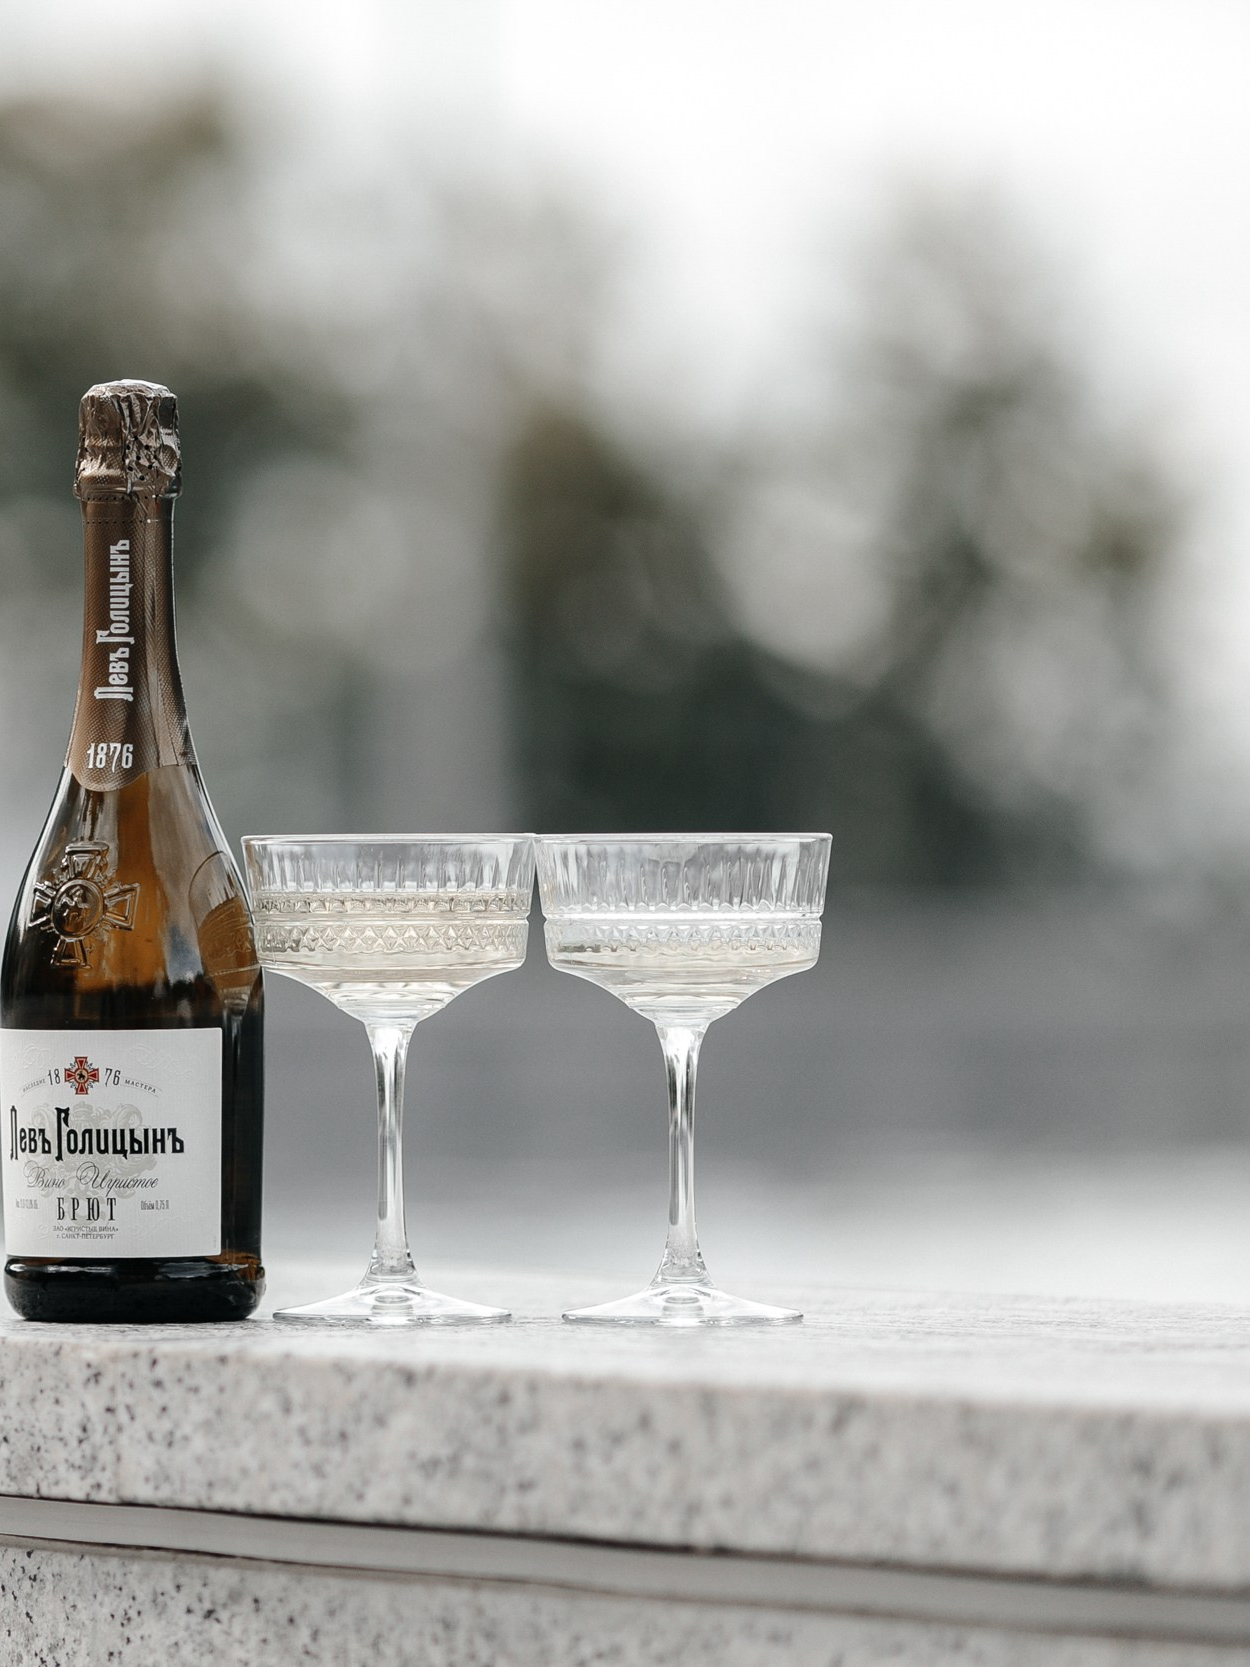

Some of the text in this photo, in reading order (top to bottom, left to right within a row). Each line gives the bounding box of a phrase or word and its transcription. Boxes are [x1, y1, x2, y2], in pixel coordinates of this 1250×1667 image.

[93, 539, 135, 702] Левъ Голицынъ
[87, 742, 134, 773] 1876
[47, 1068, 61, 1086] 18
[104, 1067, 122, 1087] 76
[124, 1079, 156, 1094] МАСТЕРА
[9, 1105, 185, 1162] Левъ Голицынъ
[23, 1160, 159, 1197] Вино Игристое
[56, 1197, 117, 1221] БРЮТ
